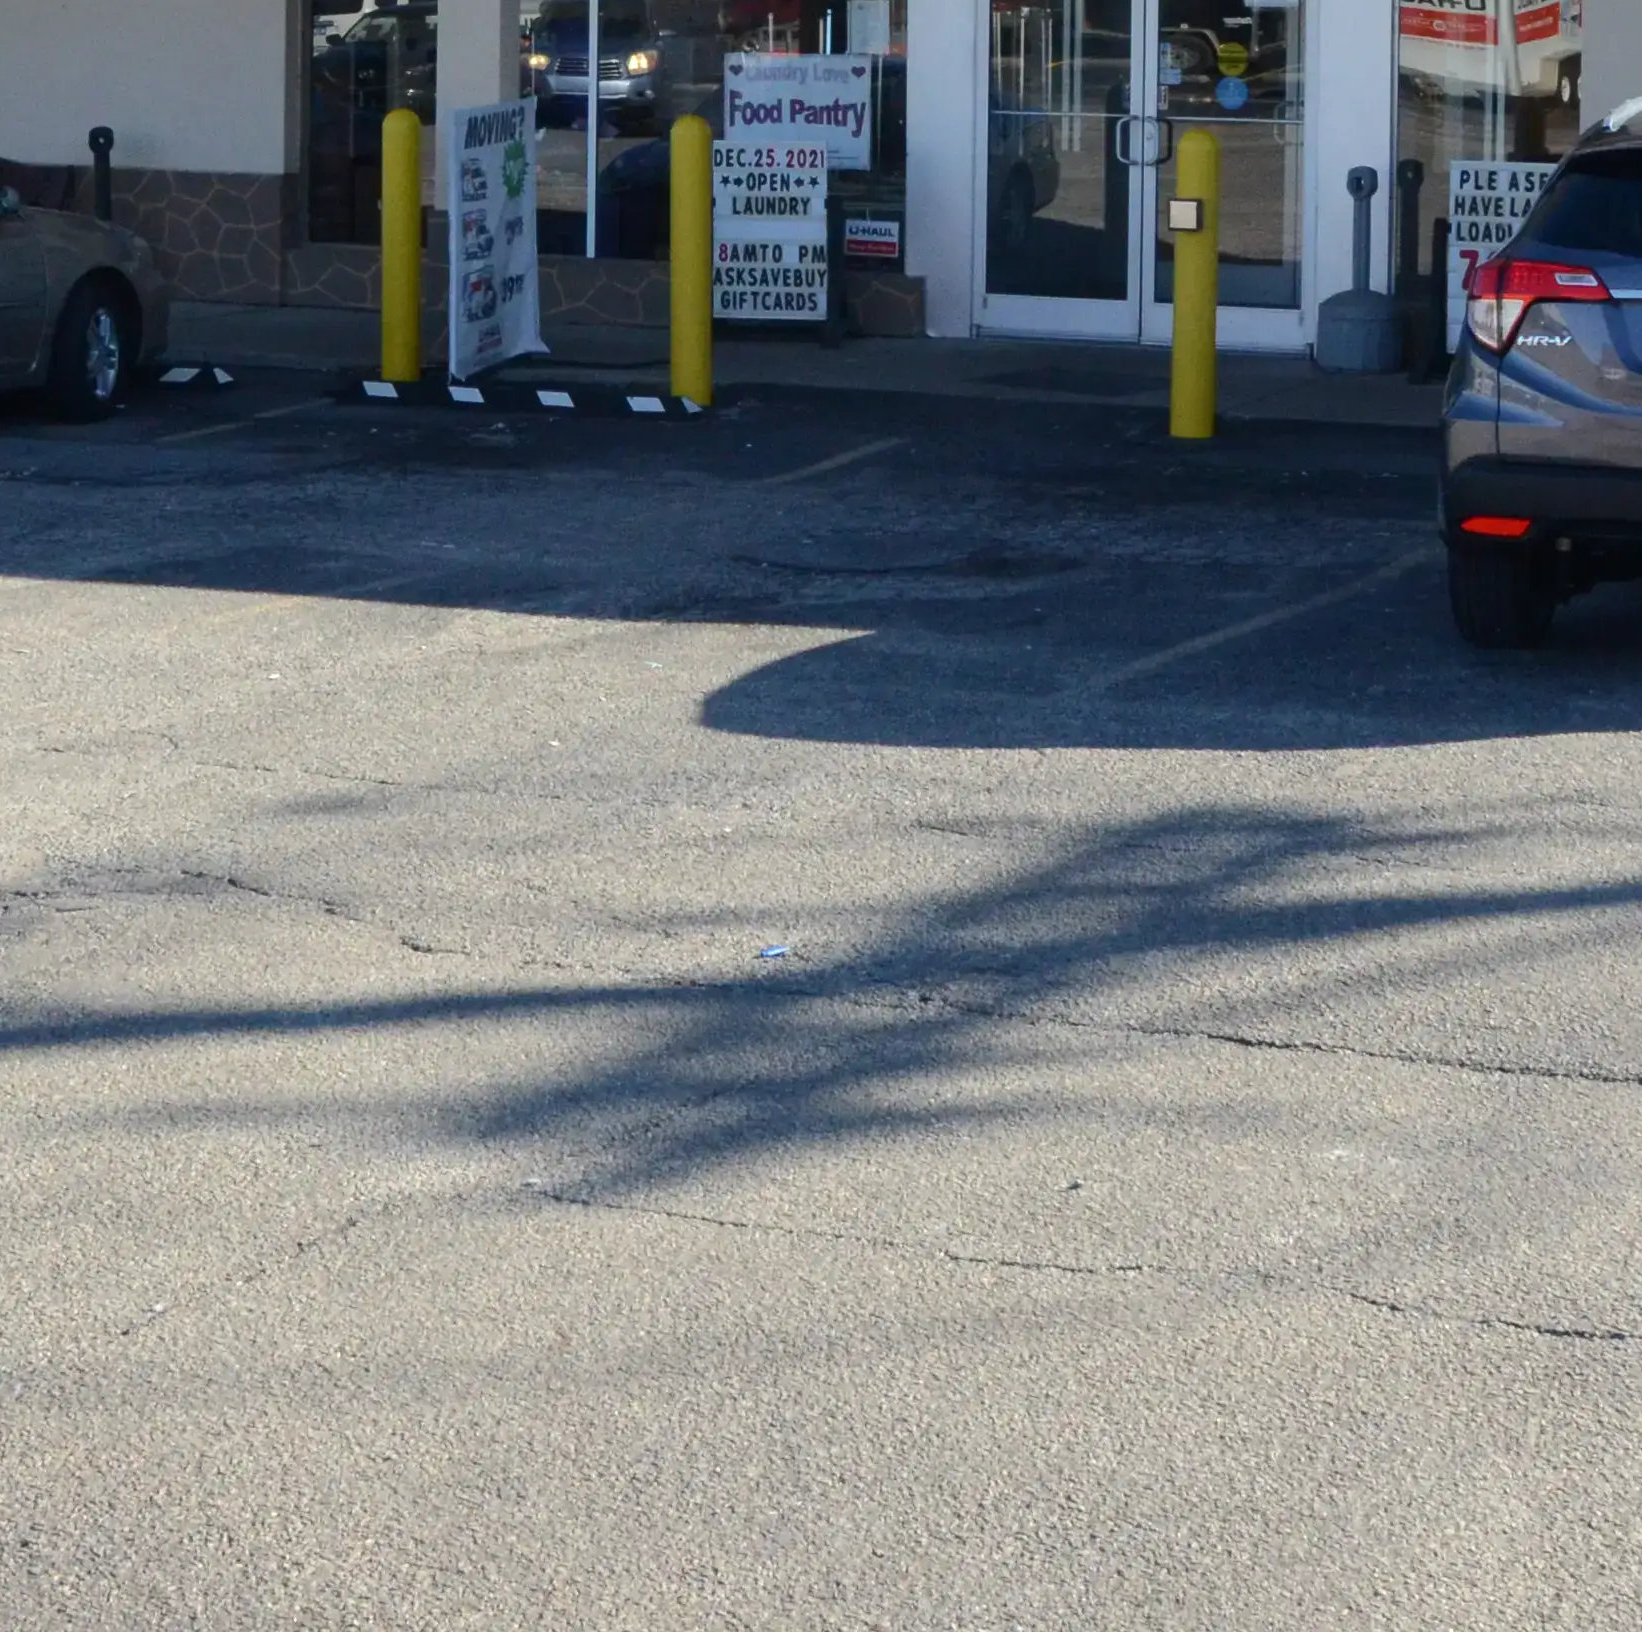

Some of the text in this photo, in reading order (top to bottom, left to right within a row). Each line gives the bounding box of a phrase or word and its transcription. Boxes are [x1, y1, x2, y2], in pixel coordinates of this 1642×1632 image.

[729, 89, 866, 139] Food Pantry
[464, 106, 525, 149] MOVING?
[785, 148, 825, 169] 2021
[746, 172, 791, 191] OPEN
[732, 196, 811, 215] LAUNDRY
[1454, 196, 1504, 217] HAVE
[798, 244, 826, 263] PM
[1517, 336, 1571, 346] HR-V
